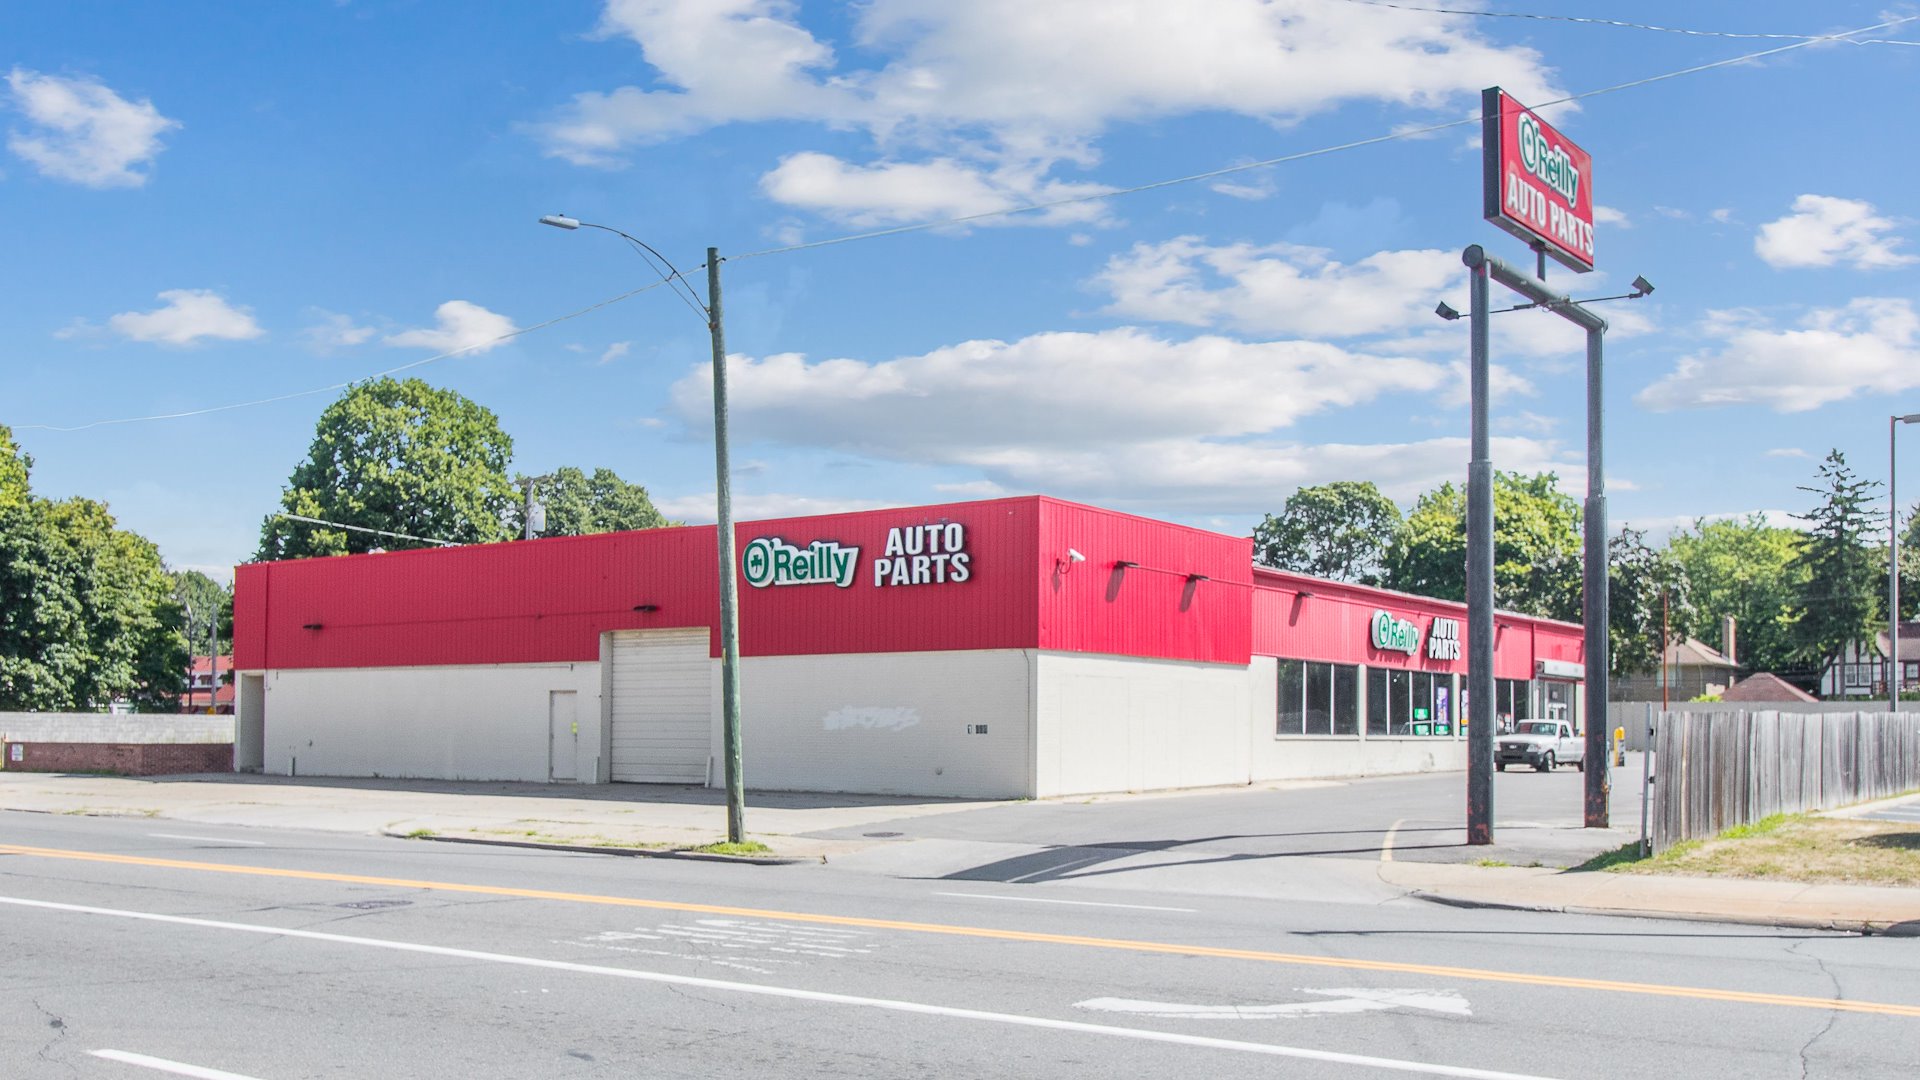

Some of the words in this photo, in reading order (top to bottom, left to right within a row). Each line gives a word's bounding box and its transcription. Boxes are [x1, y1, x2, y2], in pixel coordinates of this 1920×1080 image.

[1519, 114, 1579, 207] O'Reilly
[1507, 174, 1546, 228] AUTO
[1549, 200, 1593, 256] PARTS
[885, 523, 963, 556] AUTO
[743, 539, 854, 585] O'Reilly
[875, 553, 969, 587] PARTS
[1375, 610, 1419, 654] OReilly
[1432, 617, 1459, 640] AUTO
[1428, 637, 1460, 660] PARTS
